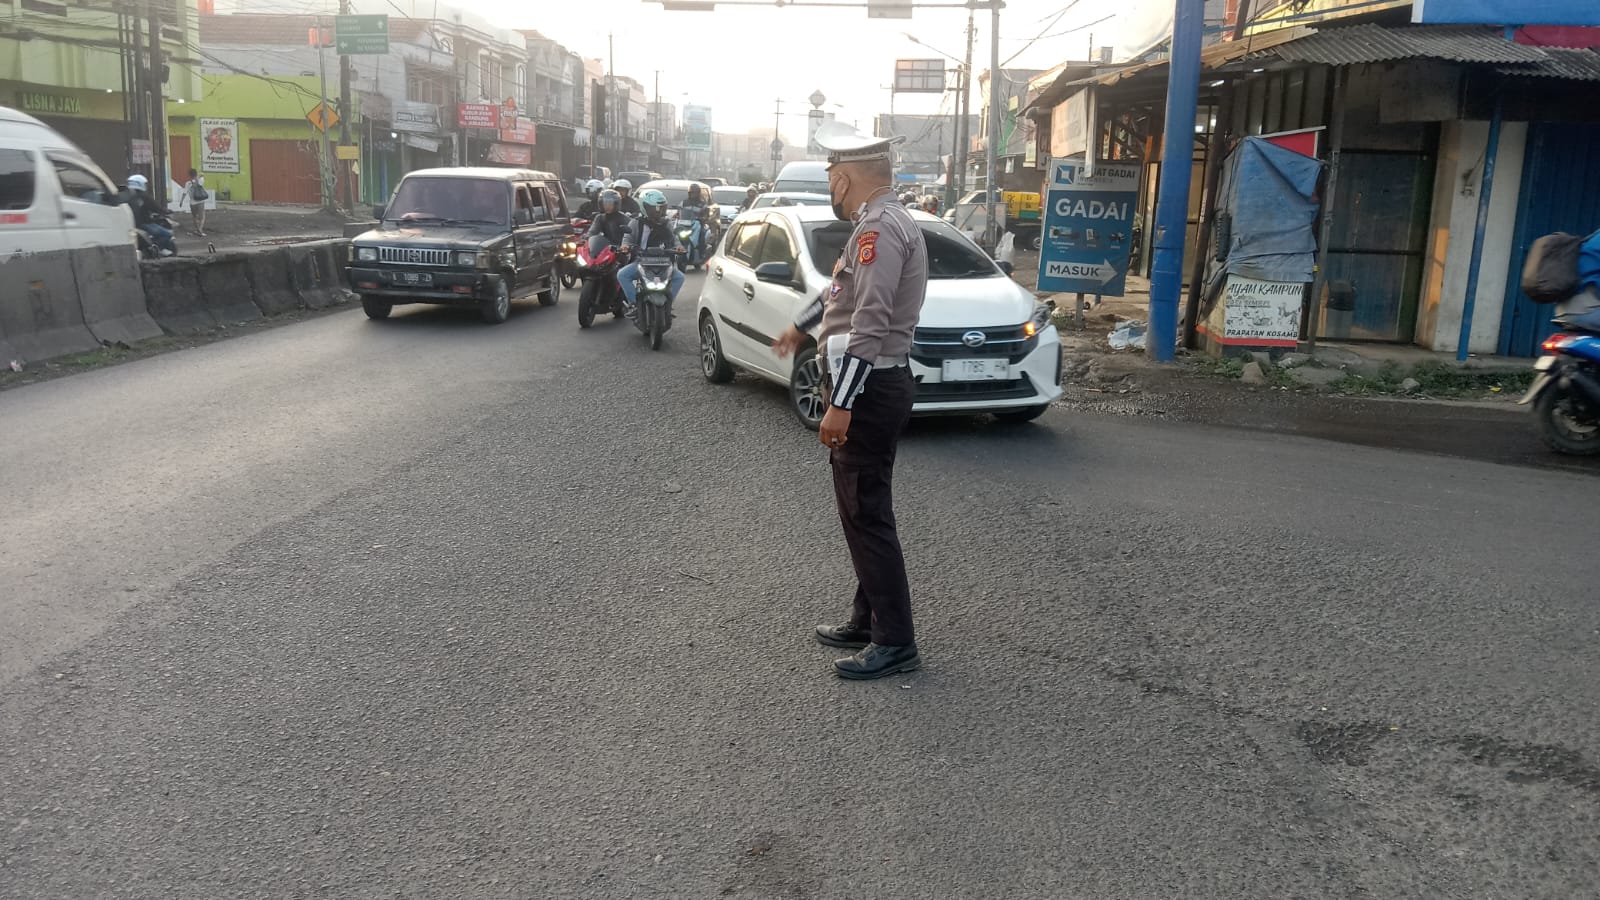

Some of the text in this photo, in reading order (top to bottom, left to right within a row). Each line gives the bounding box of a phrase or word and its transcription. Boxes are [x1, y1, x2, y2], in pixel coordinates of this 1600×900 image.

[58, 97, 81, 113] JAYA
[1108, 168, 1136, 179] GADAI
[1055, 198, 1128, 221] GADAI
[1049, 264, 1100, 277] MASUK
[1227, 283, 1257, 297] AYAM
